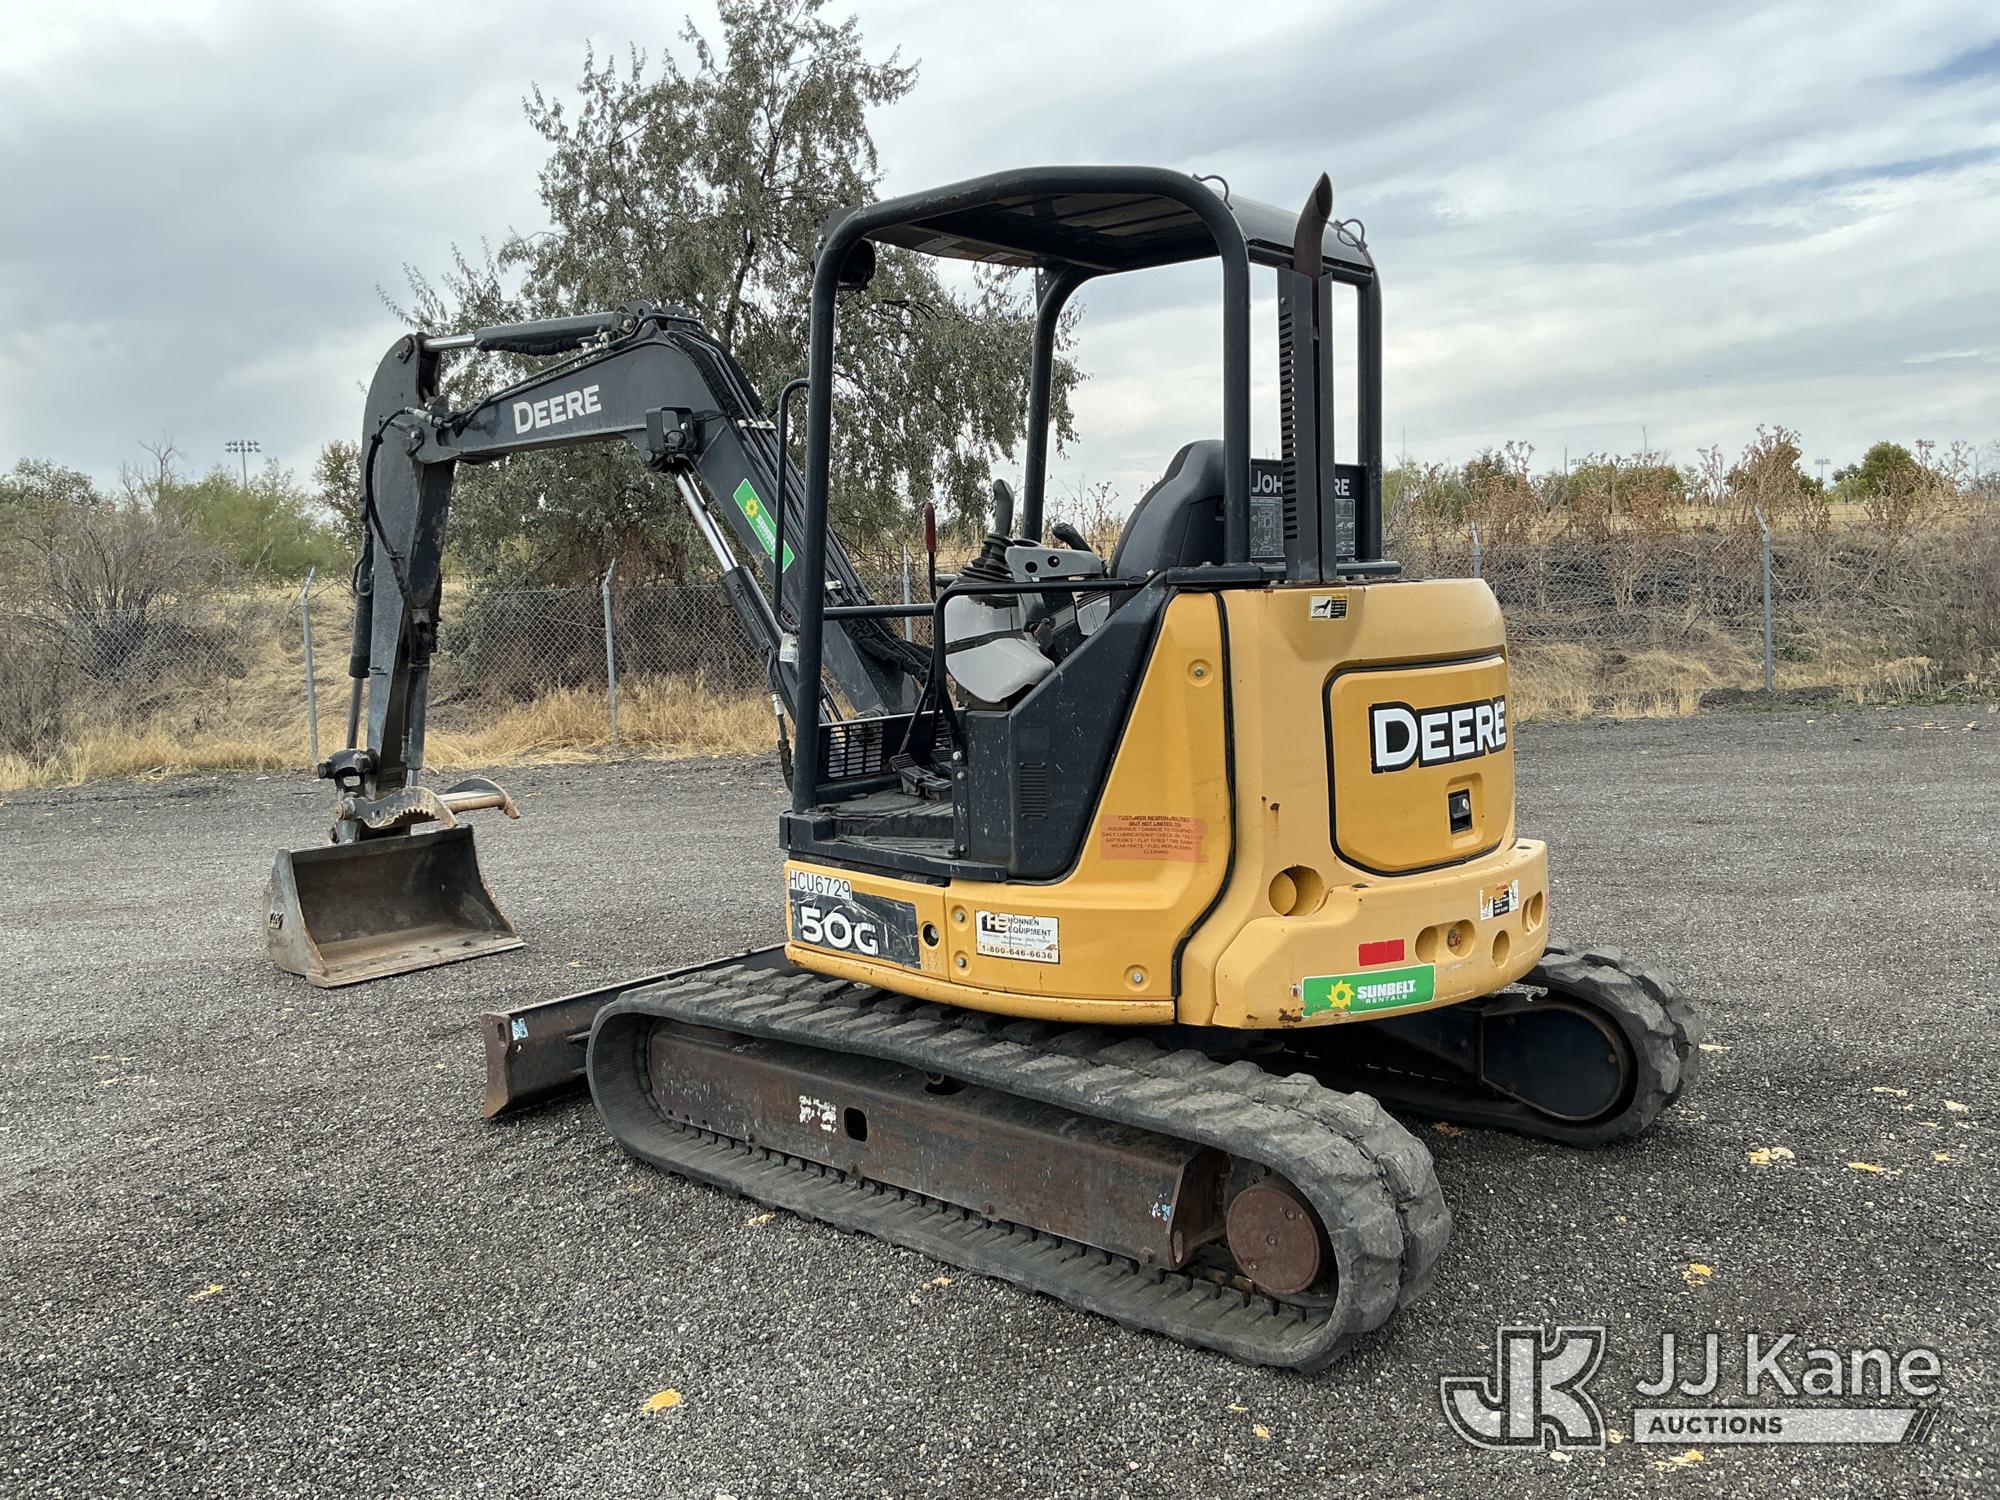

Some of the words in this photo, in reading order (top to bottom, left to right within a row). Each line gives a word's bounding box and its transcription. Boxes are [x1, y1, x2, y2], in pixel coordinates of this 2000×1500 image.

[513, 385, 601, 434] DEERE
[1252, 471, 1283, 494] JOH
[1373, 701, 1507, 768] DEERE
[789, 870, 852, 900] HCU6729
[801, 906, 879, 956] 50G
[1008, 917, 1040, 926] HONNEN
[1008, 926, 1052, 937] EQUIPMENT
[982, 945, 1053, 960] 1-800-646-6636
[1357, 980, 1416, 1000] SUNBELT
[1365, 993, 1408, 1004] RENTALS
